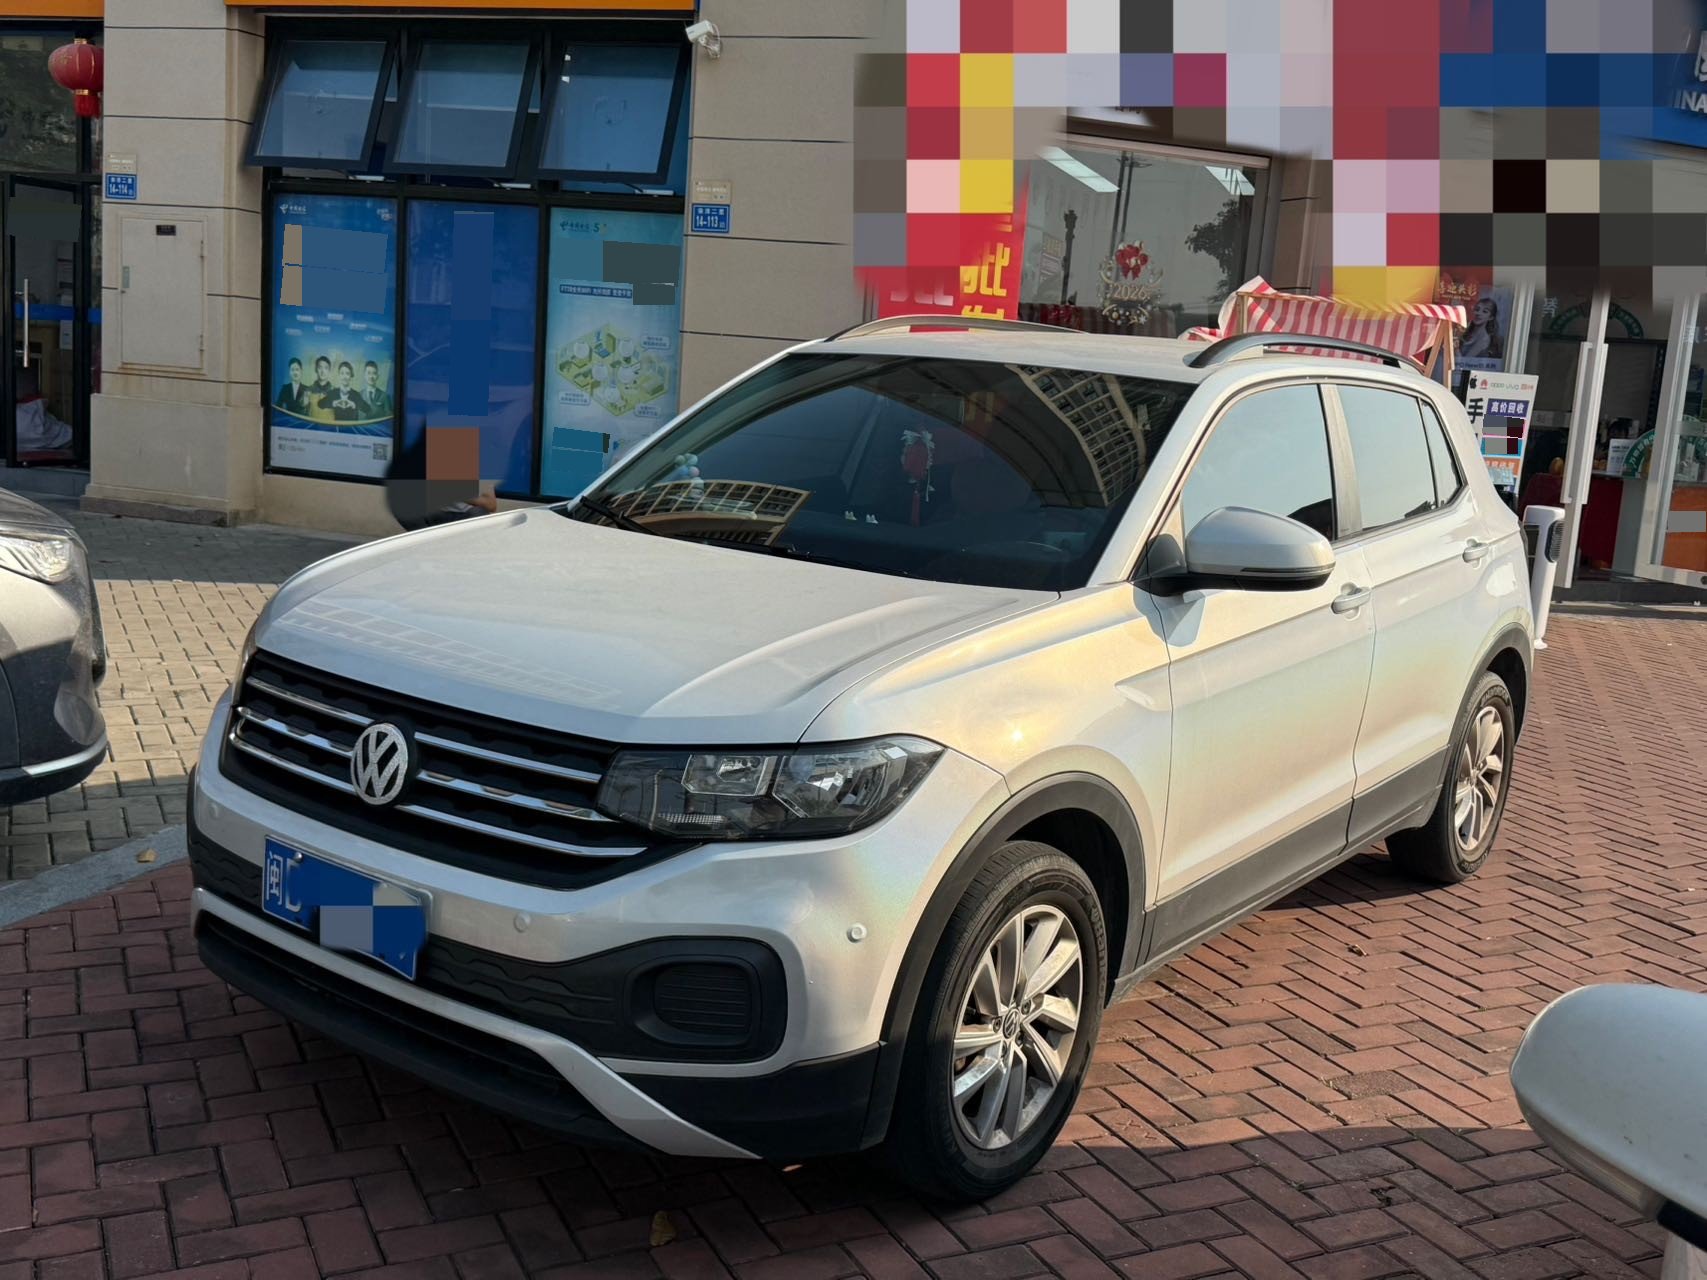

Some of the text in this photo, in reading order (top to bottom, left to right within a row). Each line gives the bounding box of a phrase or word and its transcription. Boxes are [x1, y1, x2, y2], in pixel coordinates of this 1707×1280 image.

[1114, 284, 1148, 300] 2026
[1467, 398, 1483, 424] 手
[1491, 402, 1525, 414] 高价回收
